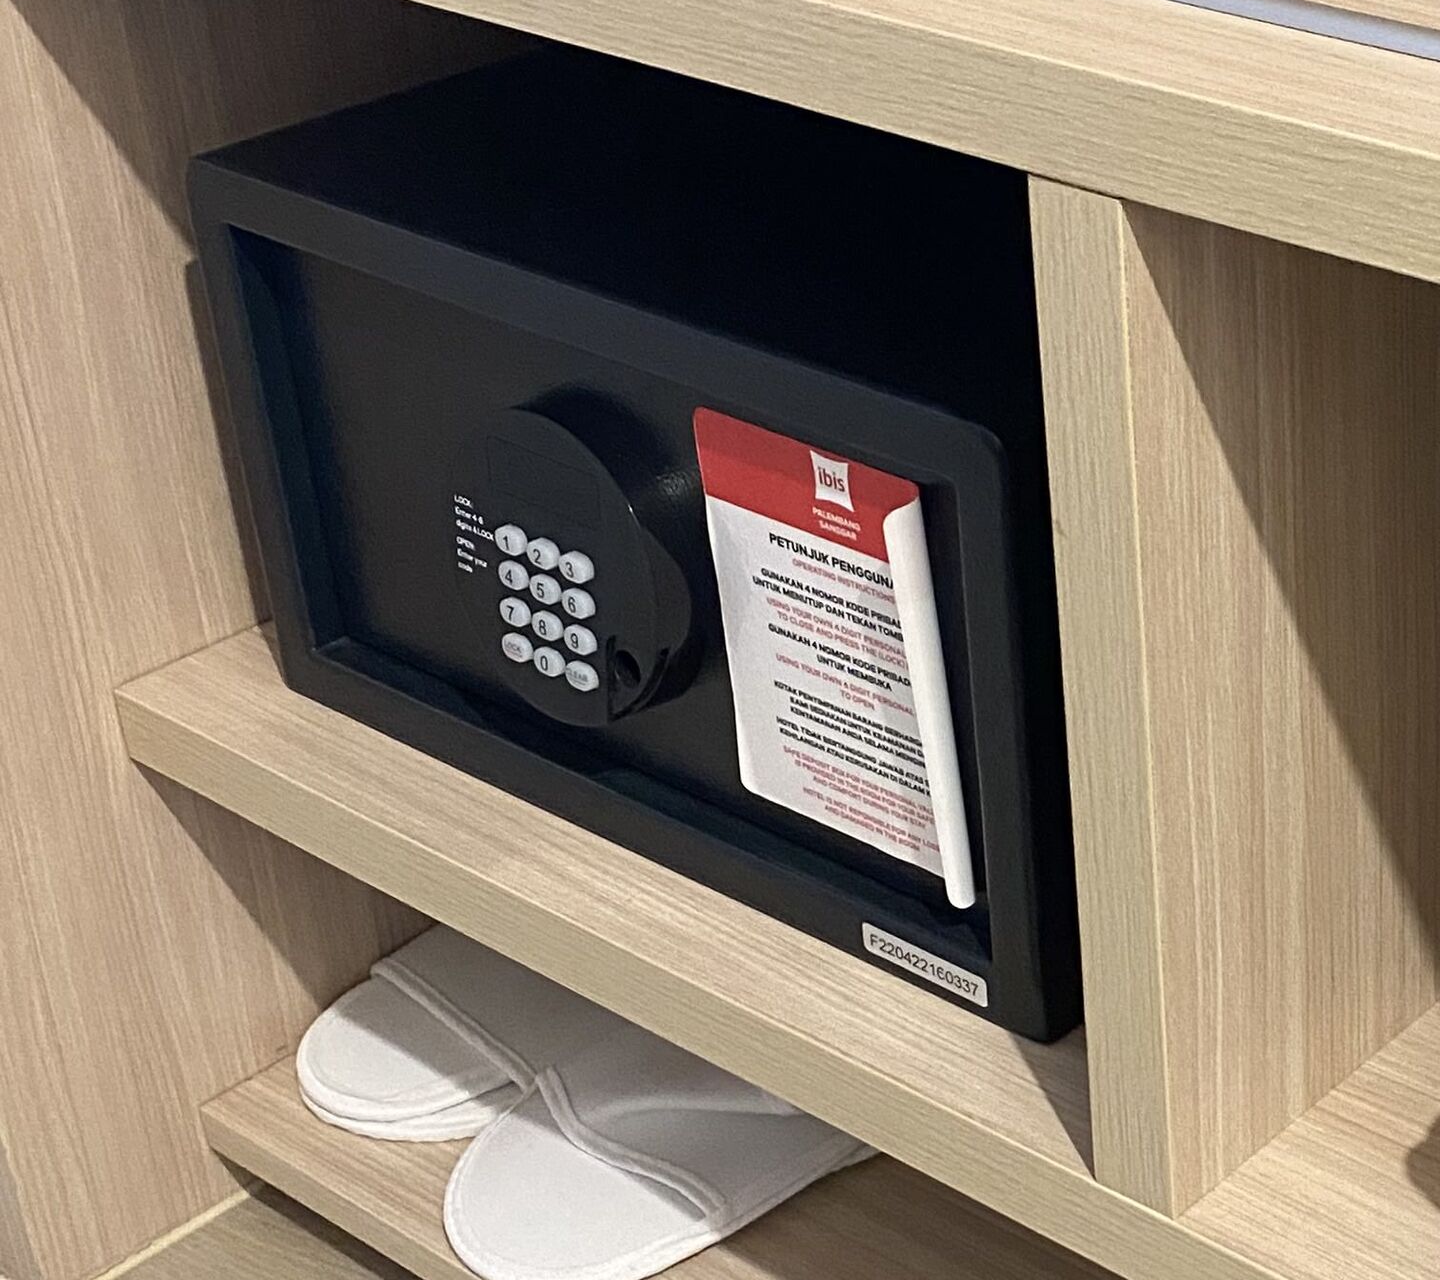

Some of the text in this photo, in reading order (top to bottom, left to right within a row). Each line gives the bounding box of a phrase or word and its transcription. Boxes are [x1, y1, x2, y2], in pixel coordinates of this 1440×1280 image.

[818, 466, 845, 492] ibis
[812, 507, 861, 532] PALEMBANG
[477, 528, 494, 541] LOCK
[819, 520, 857, 541] SANGGAR
[502, 536, 509, 550] 1
[769, 532, 830, 565] PETUNJUK
[533, 549, 542, 564] 2
[505, 570, 512, 584] 4
[566, 562, 574, 578] 3
[536, 583, 544, 598] 5
[792, 558, 895, 604] OPERATING INSTRUCTIONS
[761, 568, 804, 590] GUNAKAN
[804, 585, 810, 593] 4
[812, 587, 844, 606] NOMOR
[846, 599, 870, 616] KODE
[506, 606, 514, 620] 7
[568, 598, 576, 613] 6
[752, 576, 782, 594] UNTUK
[783, 588, 824, 608] MENUTUP
[826, 605, 844, 619] DAN
[846, 611, 876, 630] TEKAN
[538, 620, 546, 635] 8
[766, 597, 790, 611] USING
[792, 607, 812, 620] YOUR
[813, 616, 832, 628] OWN
[841, 626, 861, 640] DIGIT
[570, 634, 578, 648] 9
[777, 610, 788, 622] TO
[790, 616, 813, 632] CLOSE
[816, 627, 832, 640] AND
[834, 634, 860, 650] PRESS
[861, 644, 877, 657] THE
[504, 641, 522, 654] LOCK
[768, 623, 810, 646] GUNAKAN
[812, 641, 818, 649] 4
[819, 643, 850, 662] NOMOR
[852, 656, 876, 674] KODE
[540, 656, 548, 670] 0
[816, 654, 892, 691] UNTUK MEMBUKA
[566, 667, 588, 683] CLEAR
[776, 652, 800, 669] USING
[800, 663, 820, 676] YOUR
[822, 672, 842, 686] OWN
[872, 692, 914, 716] PERSONAL
[774, 680, 798, 694] KOTAK
[840, 690, 875, 710] TO OPEN
[776, 716, 799, 732] HOTEL
[800, 726, 822, 740] TIDAK
[870, 934, 979, 996] F220422160337
